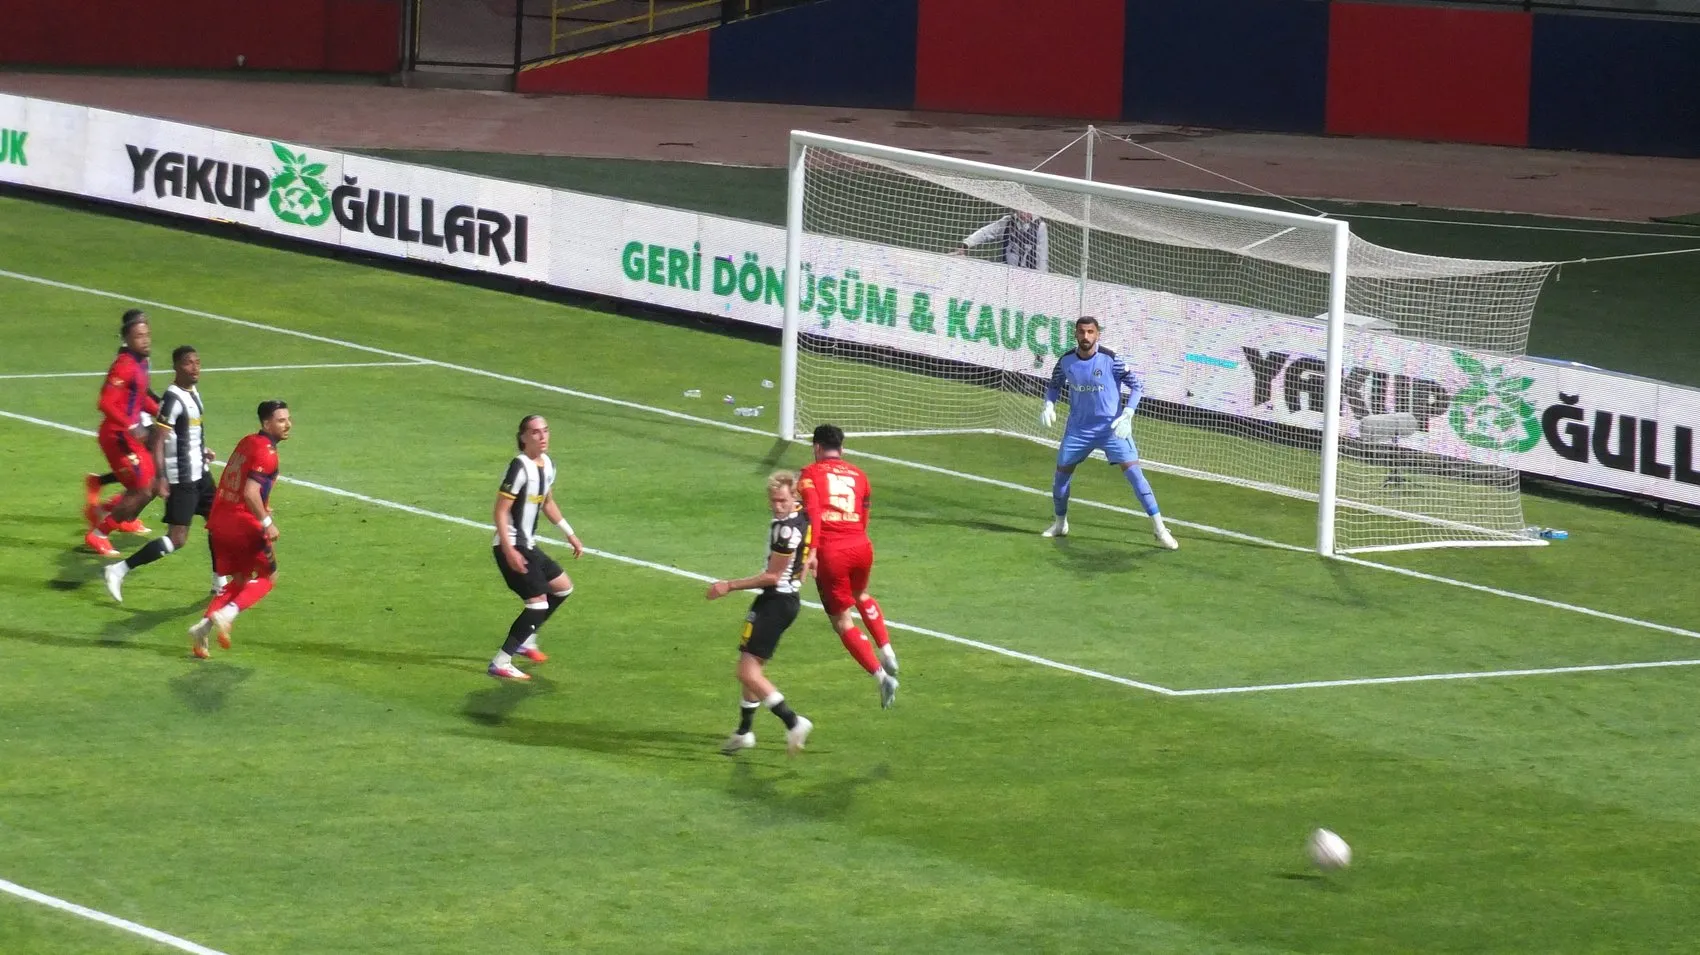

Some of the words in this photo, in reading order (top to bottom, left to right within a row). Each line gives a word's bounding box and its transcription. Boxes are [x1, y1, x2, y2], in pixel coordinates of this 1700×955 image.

[125, 144, 270, 212] YAKUP
[332, 174, 528, 265] ĞULLARI
[622, 241, 701, 291] GERİ
[713, 252, 897, 329] DÖNÜŞÜM
[910, 292, 936, 334] &
[946, 297, 1104, 368] KAUÇU
